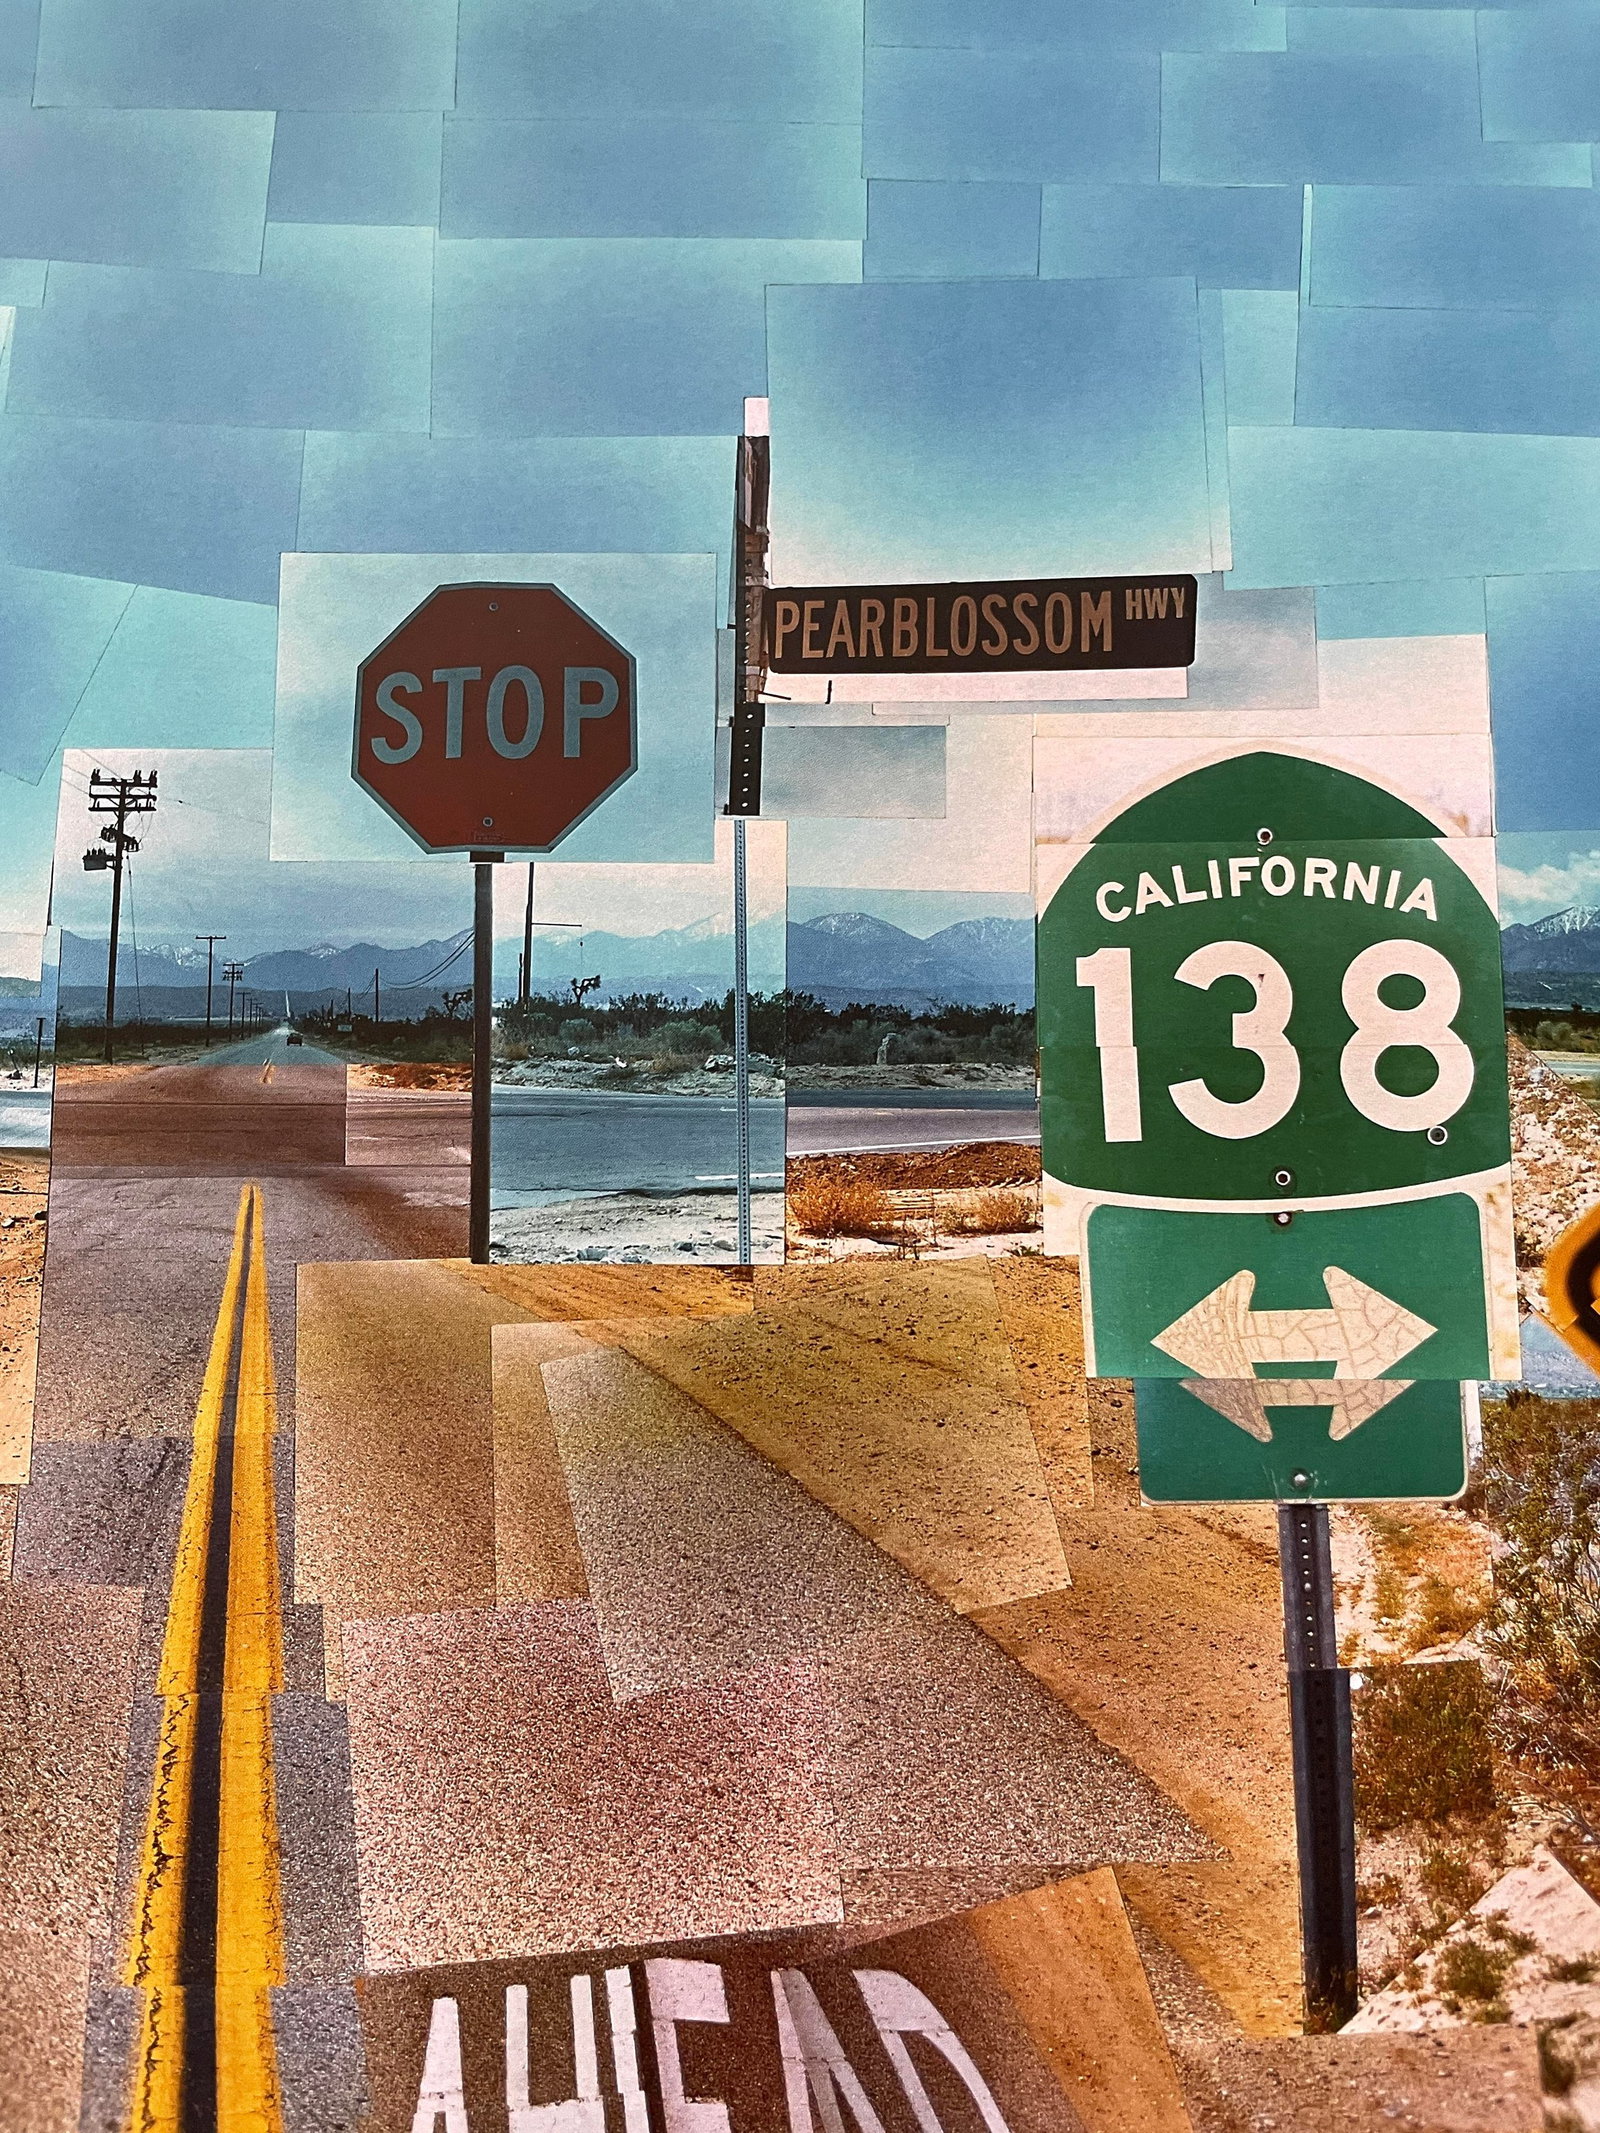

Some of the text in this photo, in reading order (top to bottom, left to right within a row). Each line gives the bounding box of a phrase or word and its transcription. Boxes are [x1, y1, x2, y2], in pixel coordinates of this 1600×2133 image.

[774, 587, 1186, 659] PEARBLOSSOM HWY
[371, 665, 619, 764] STOP
[1095, 856, 1438, 923] CALIFORNIA
[1076, 939, 1475, 1142] 138
